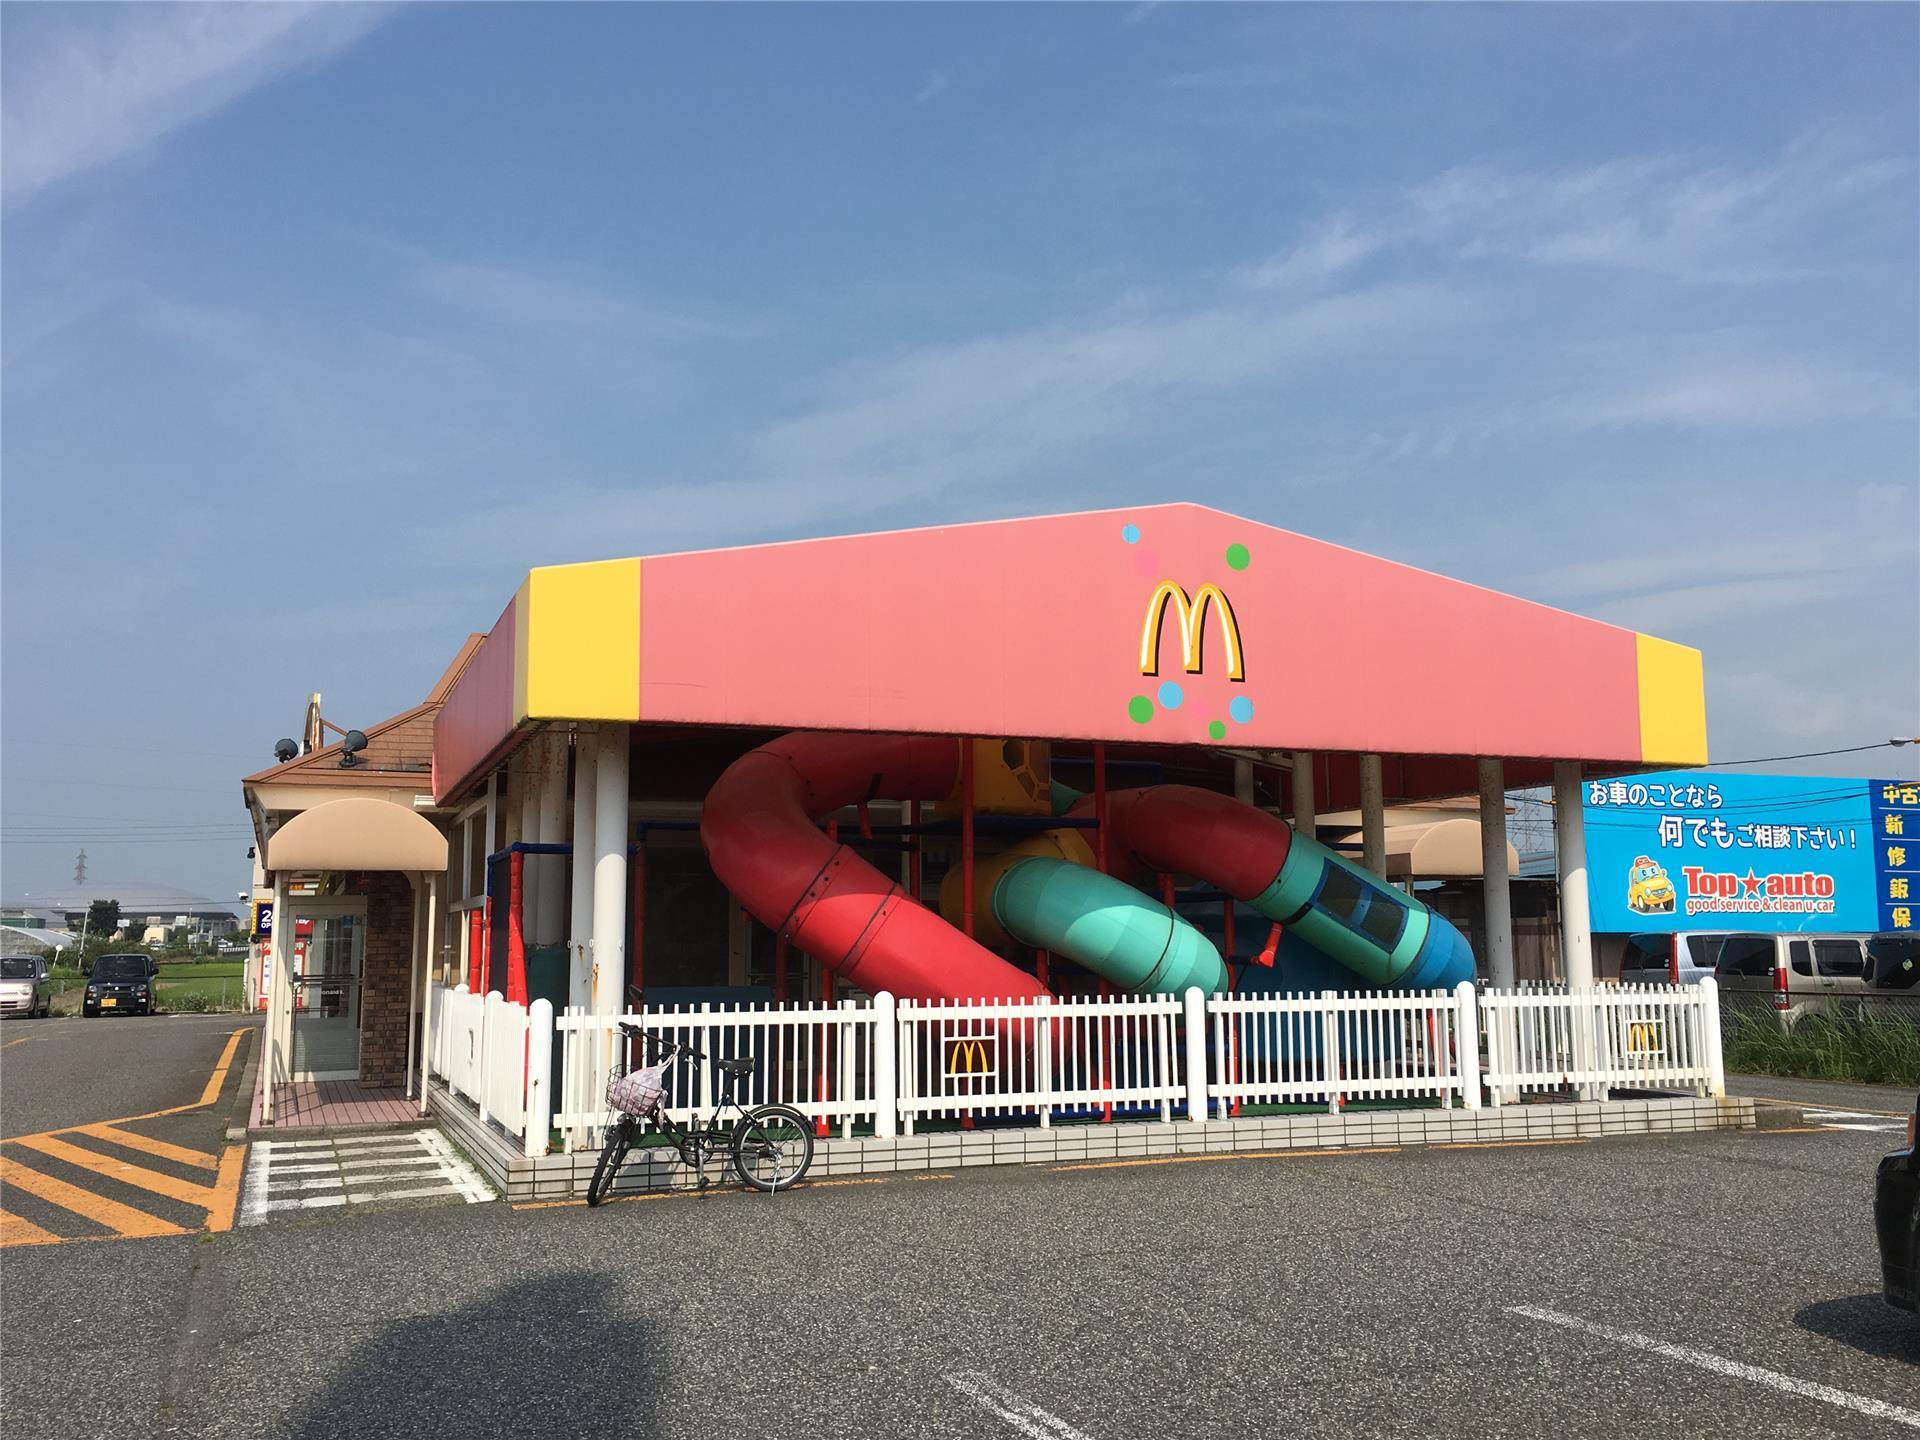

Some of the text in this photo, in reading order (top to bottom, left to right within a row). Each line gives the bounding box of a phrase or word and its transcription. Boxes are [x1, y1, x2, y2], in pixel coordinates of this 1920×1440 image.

[1588, 780, 1723, 808] お車のことなら
[1887, 846, 1906, 867] 修
[1687, 897, 1717, 913] good
[1720, 897, 1760, 911] service
[1762, 897, 1773, 911] &
[1773, 896, 1803, 911] clean
[261, 910, 273, 922] 2
[1891, 907, 1912, 928] 保
